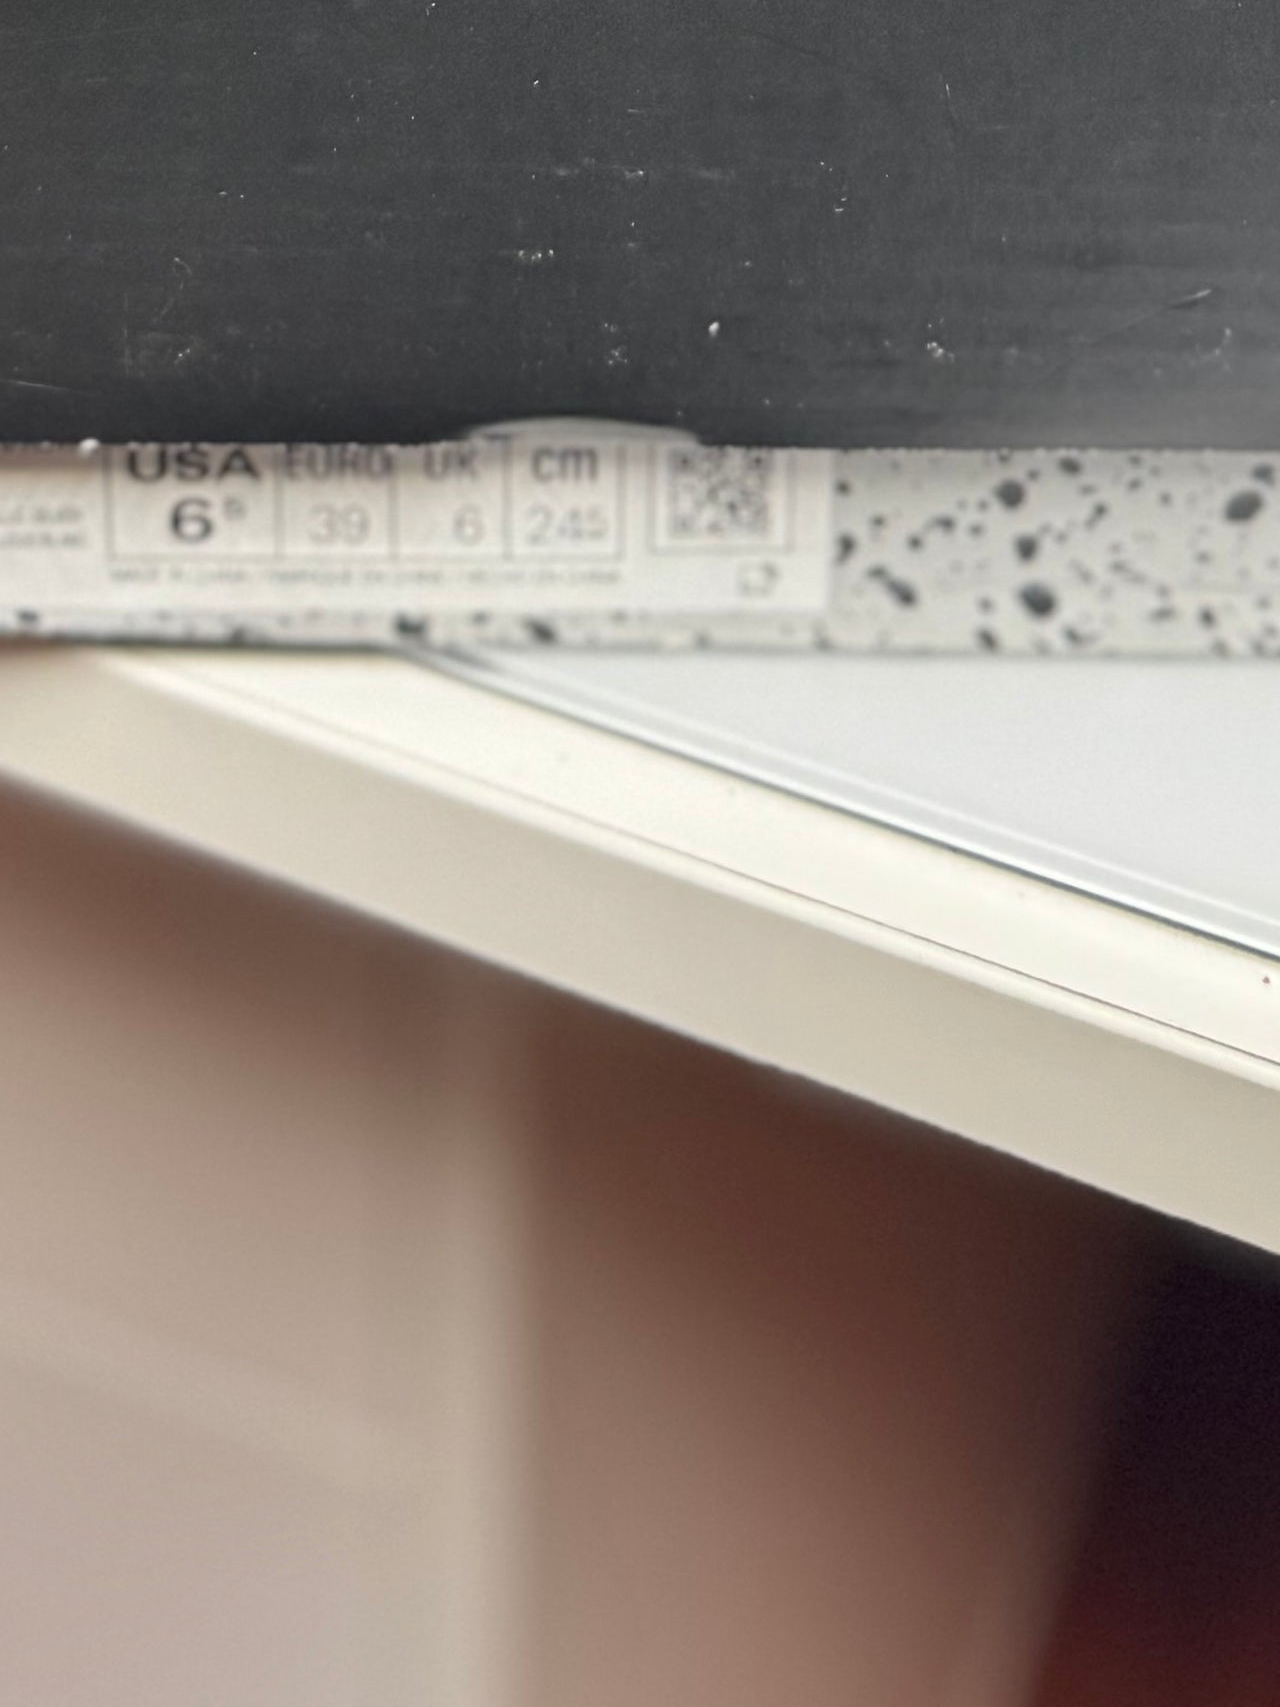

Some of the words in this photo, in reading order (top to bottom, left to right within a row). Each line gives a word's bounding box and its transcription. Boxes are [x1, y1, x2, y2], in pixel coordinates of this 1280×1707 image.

[126, 444, 263, 483] USA
[423, 444, 479, 481] UK
[531, 446, 599, 483] cm
[308, 502, 369, 544] 39
[452, 502, 487, 545] 6
